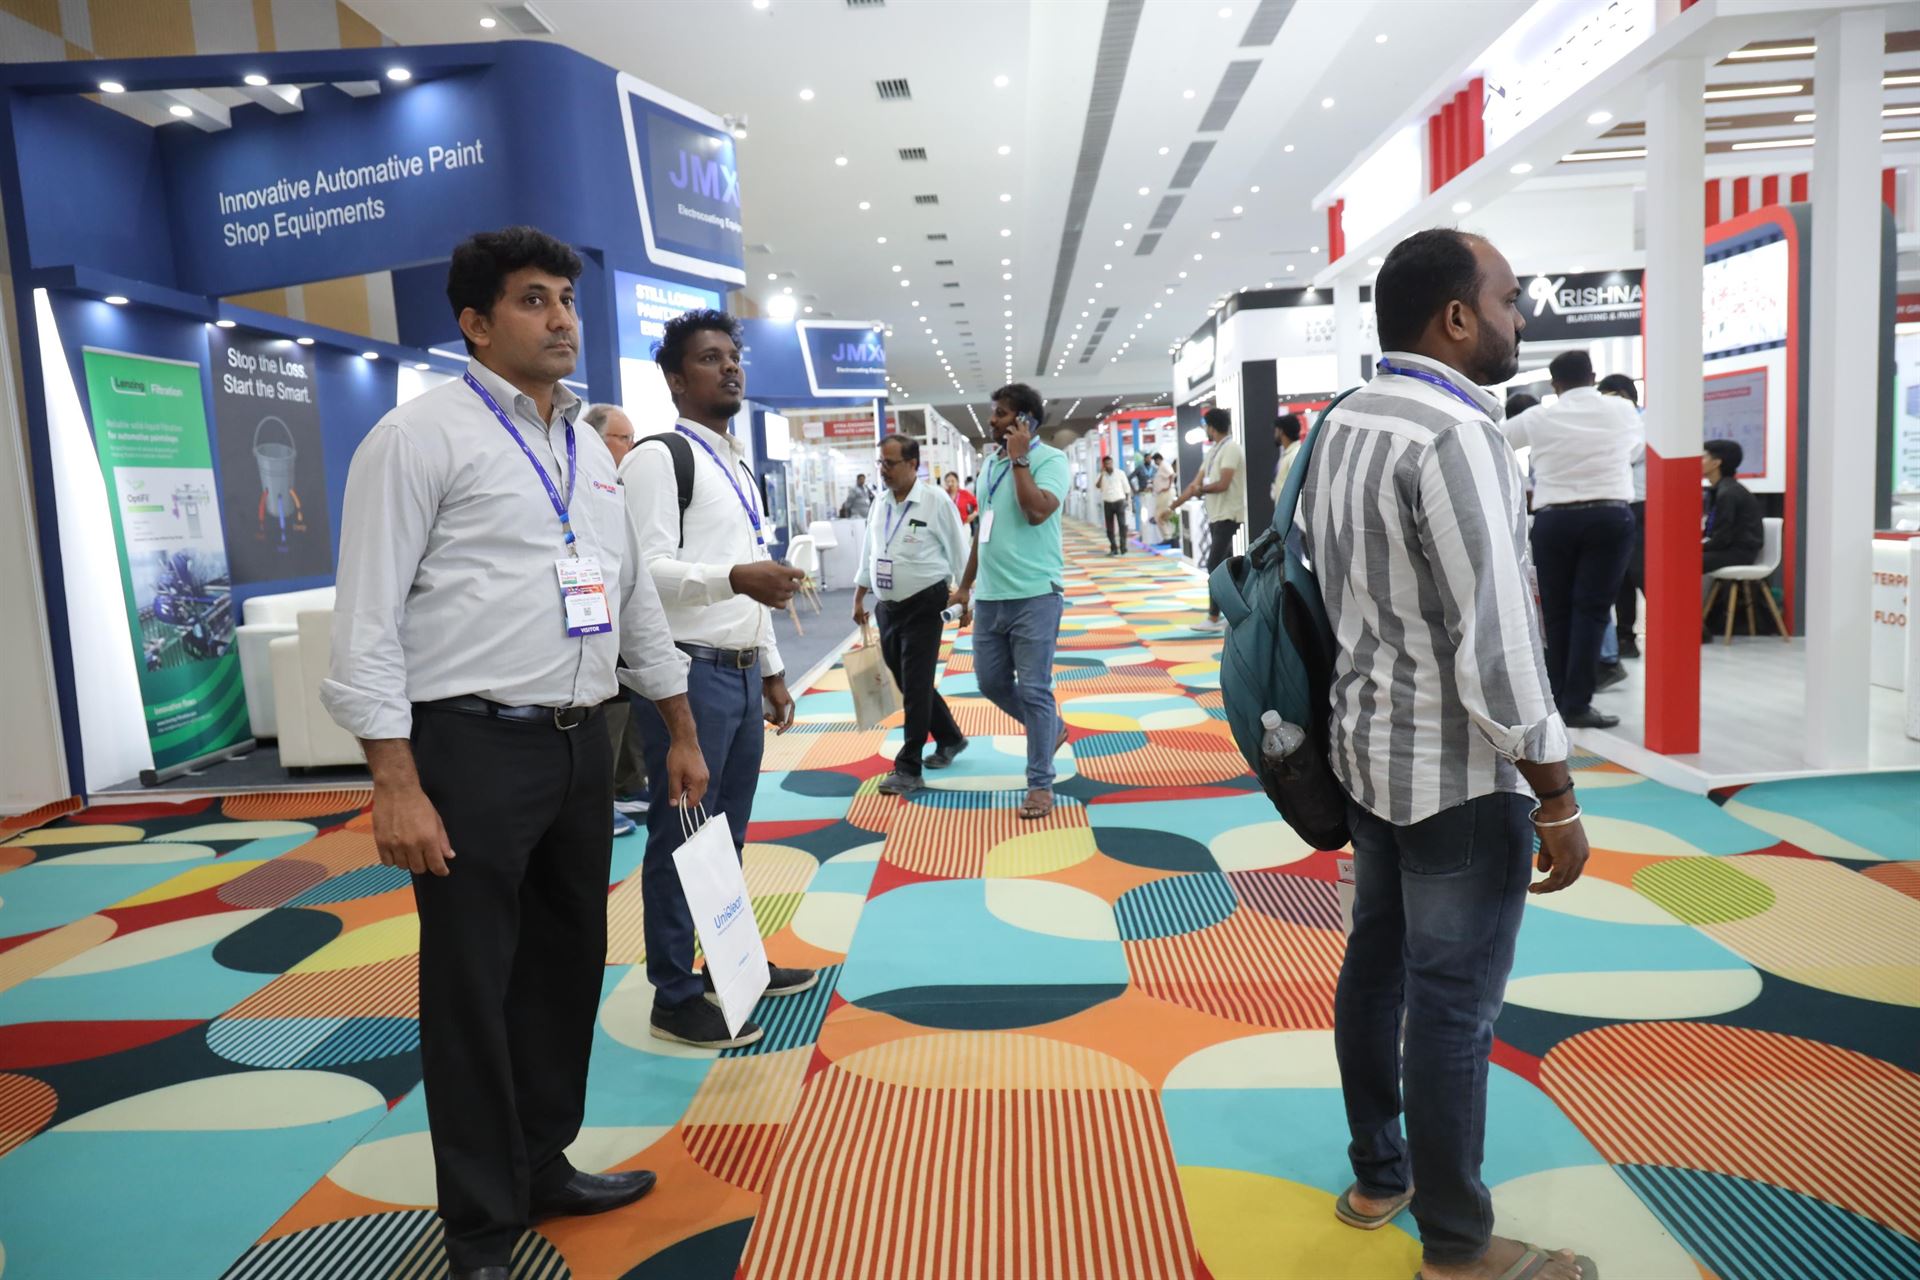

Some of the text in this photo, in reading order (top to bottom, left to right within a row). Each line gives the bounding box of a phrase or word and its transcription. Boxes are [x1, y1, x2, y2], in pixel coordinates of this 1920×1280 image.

[219, 138, 484, 215] Innovative Automative Paint
[668, 149, 740, 208] JMX
[223, 196, 386, 247] Shop Equipments
[227, 347, 308, 379] Stop the Loss.
[223, 374, 312, 404] Start the Smart.
[580, 625, 600, 633] VISITOR
[1874, 610, 1907, 627] FLOO
